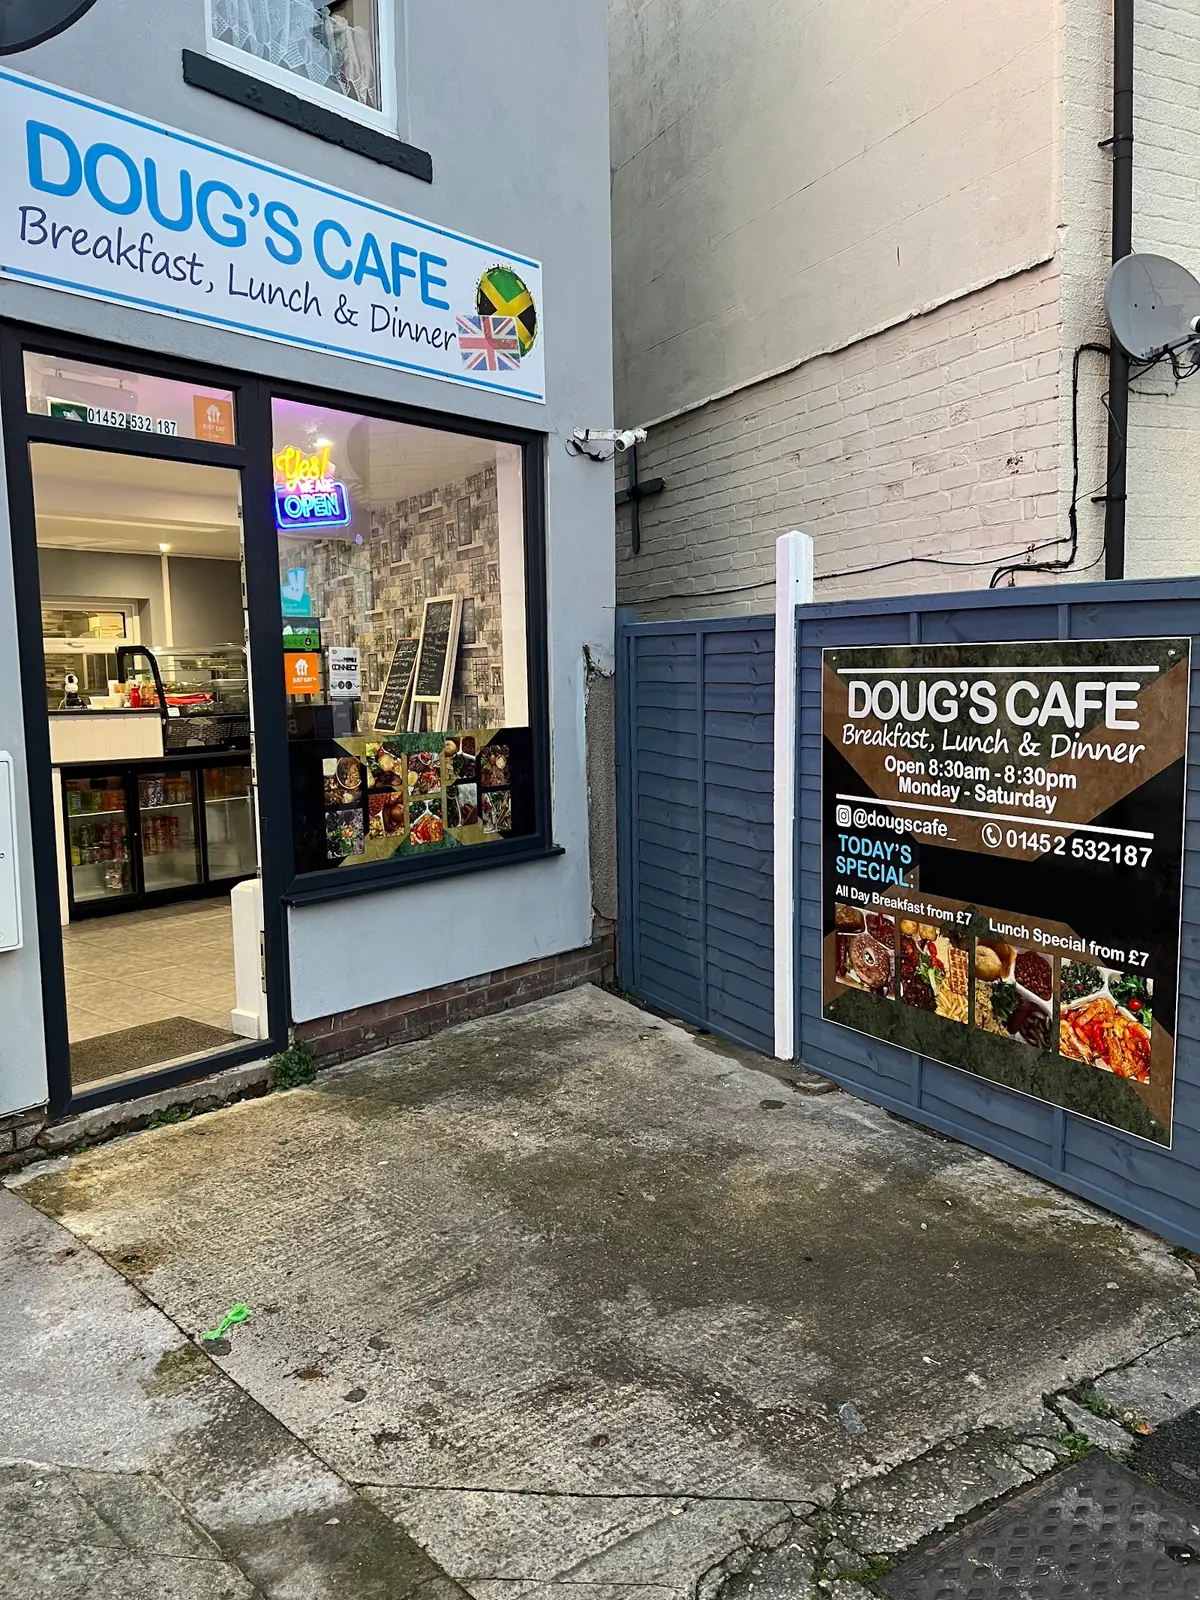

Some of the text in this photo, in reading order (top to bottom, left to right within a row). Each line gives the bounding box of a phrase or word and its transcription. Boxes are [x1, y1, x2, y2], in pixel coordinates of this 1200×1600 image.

[26, 119, 450, 310] DOUG'S CAFE
[18, 205, 457, 351] Breakfast, Lunch & Dinner
[87, 408, 125, 427] 01452
[131, 415, 151, 431] 532
[157, 419, 176, 435] 187
[284, 493, 340, 518] OPEN
[849, 680, 1141, 730] DOUG'S CAFE
[842, 723, 1145, 764] Breakfast, Lunch & Dinner
[884, 755, 925, 779] Open
[928, 759, 990, 781] 8:30am
[1004, 765, 1077, 789] 8:30pm
[899, 776, 961, 804] Monday
[974, 784, 1058, 814] Saturday
[838, 834, 912, 865] TODAY'S
[1006, 829, 1066, 856] 01452
[1071, 838, 1152, 868] 532187
[836, 855, 915, 889] SPECIAL:
[835, 884, 972, 926] All Day Breakfast from £7
[988, 918, 1150, 968] Lunch Special from £7
